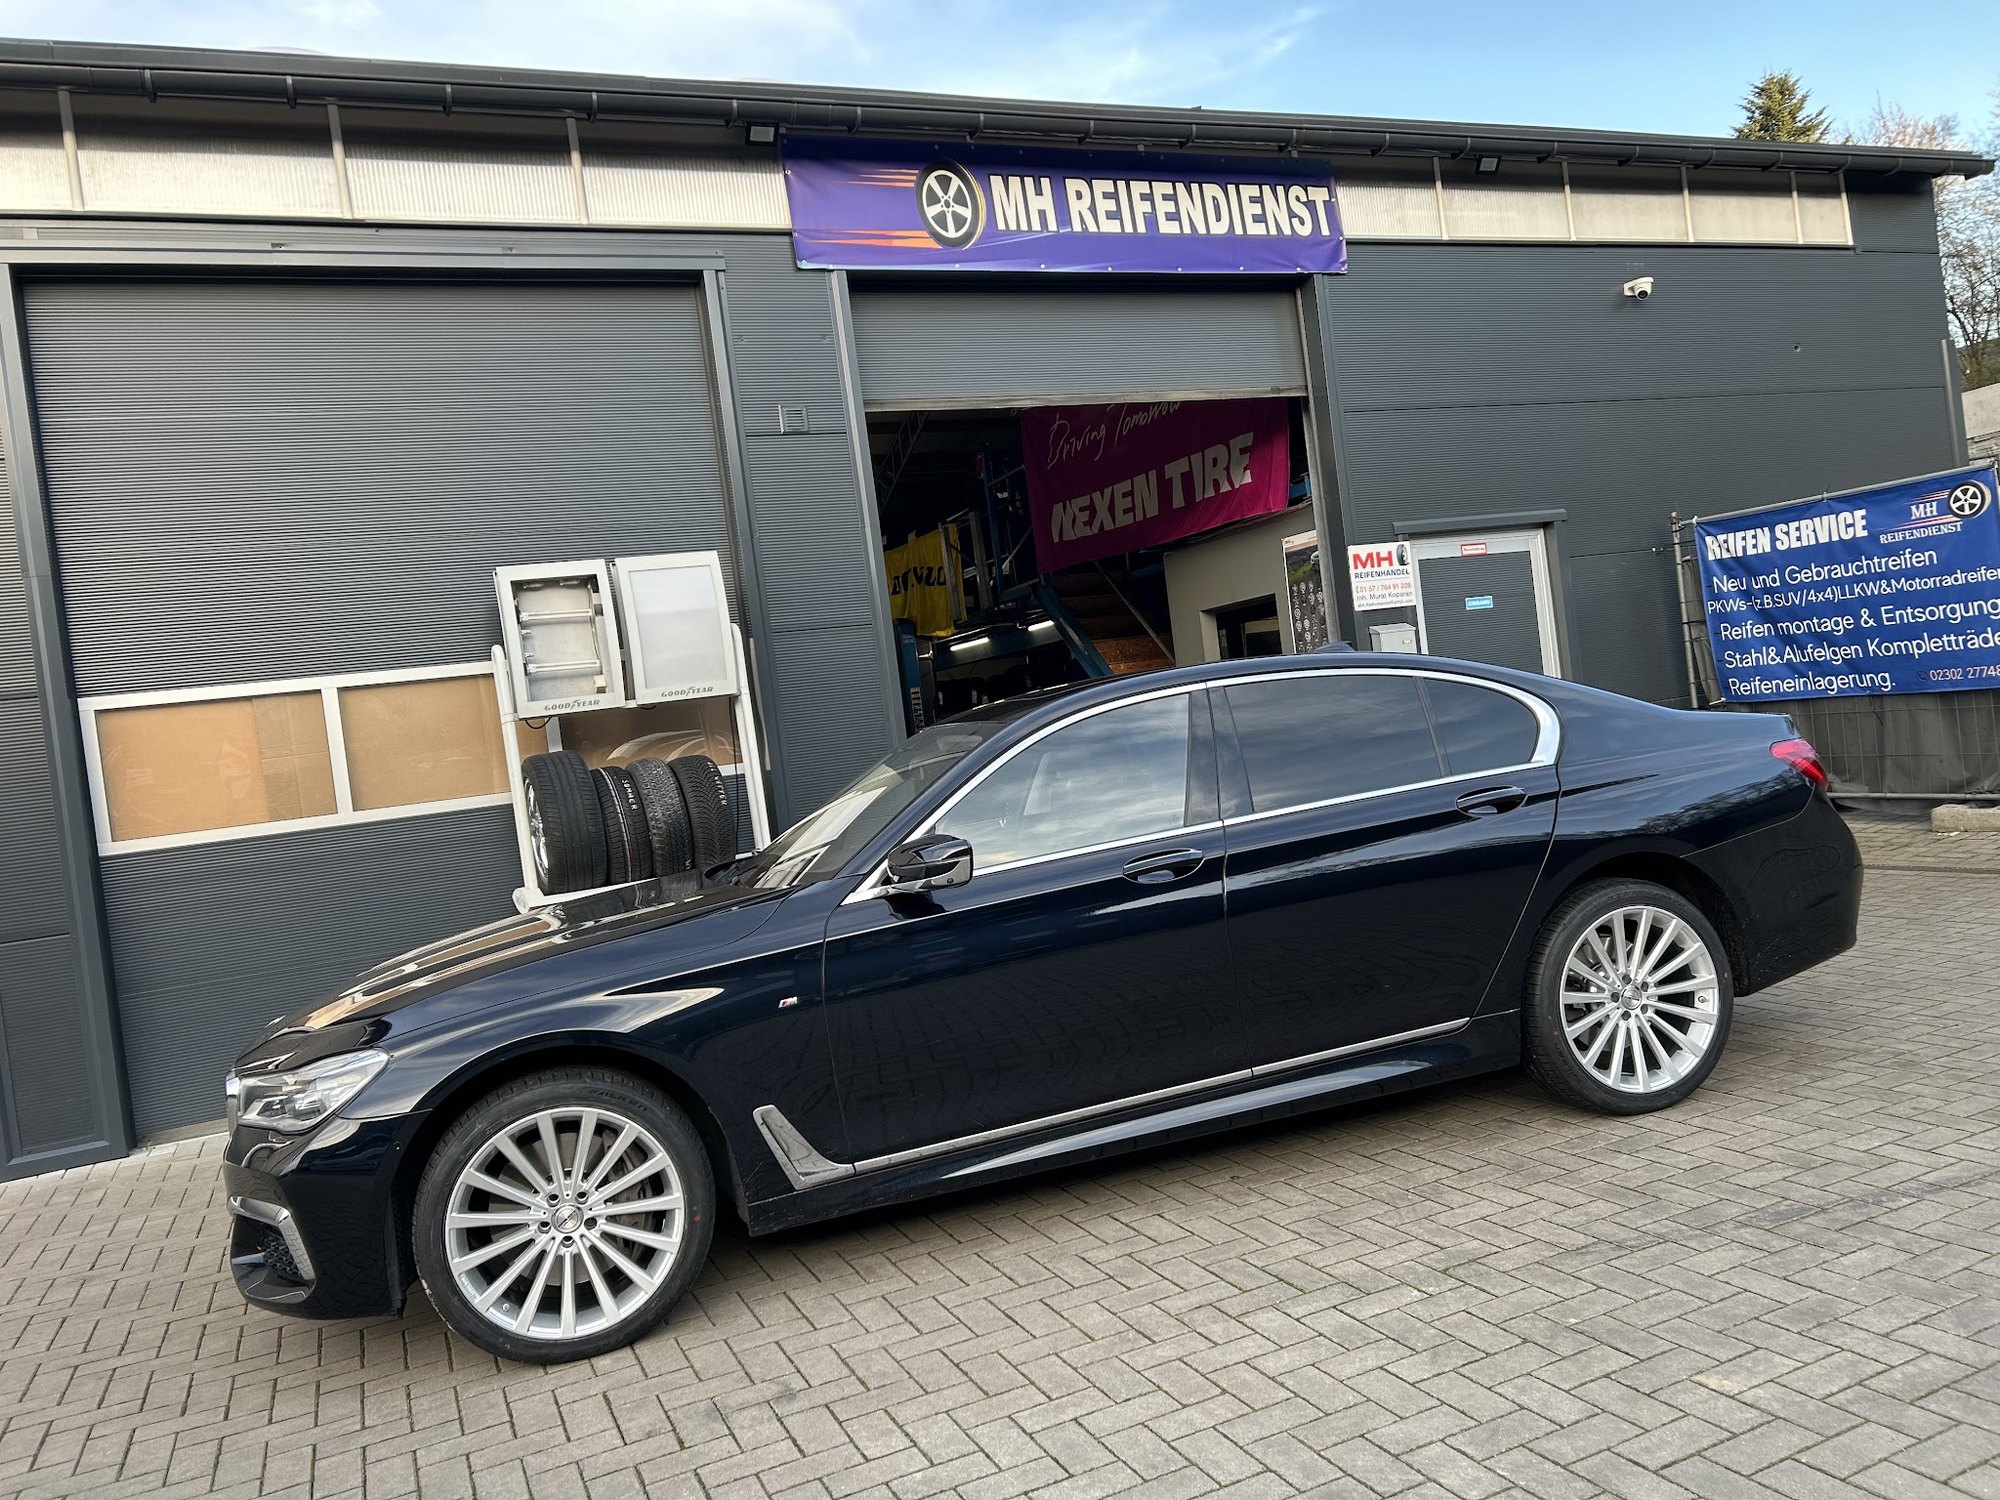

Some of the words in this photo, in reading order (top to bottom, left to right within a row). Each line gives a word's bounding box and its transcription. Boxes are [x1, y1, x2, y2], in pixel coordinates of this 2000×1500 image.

[989, 174, 1059, 232] MH
[1064, 177, 1331, 237] REIFENDIENST
[1047, 412, 1106, 470] Driving
[1051, 469, 1159, 543] NEXEN
[1164, 432, 1254, 509] TIRE
[1909, 501, 1939, 520] MH
[1704, 527, 1772, 561] REIFEN
[1774, 508, 1869, 551] SERVICE
[1879, 521, 1964, 544] REIFENDIENST
[1352, 550, 1394, 570] MH
[1712, 575, 1747, 594] Neu
[1751, 568, 1781, 589] und
[1784, 548, 1938, 585] Gebrauchtreifen
[1354, 568, 1410, 579] REIFENHANDEL
[1720, 620, 1775, 641] Reifen
[1776, 614, 1854, 635] montage
[1860, 608, 1877, 628] &
[1881, 598, 2000, 626] Entsorgung
[1723, 641, 1864, 669] Stahl&Alufelgen
[1728, 671, 1896, 696] Reifeneinlagerung.
[1929, 668, 1964, 681] 02302
[661, 686, 714, 698] GOODYEAR
[544, 699, 601, 711] GOODYEAR
